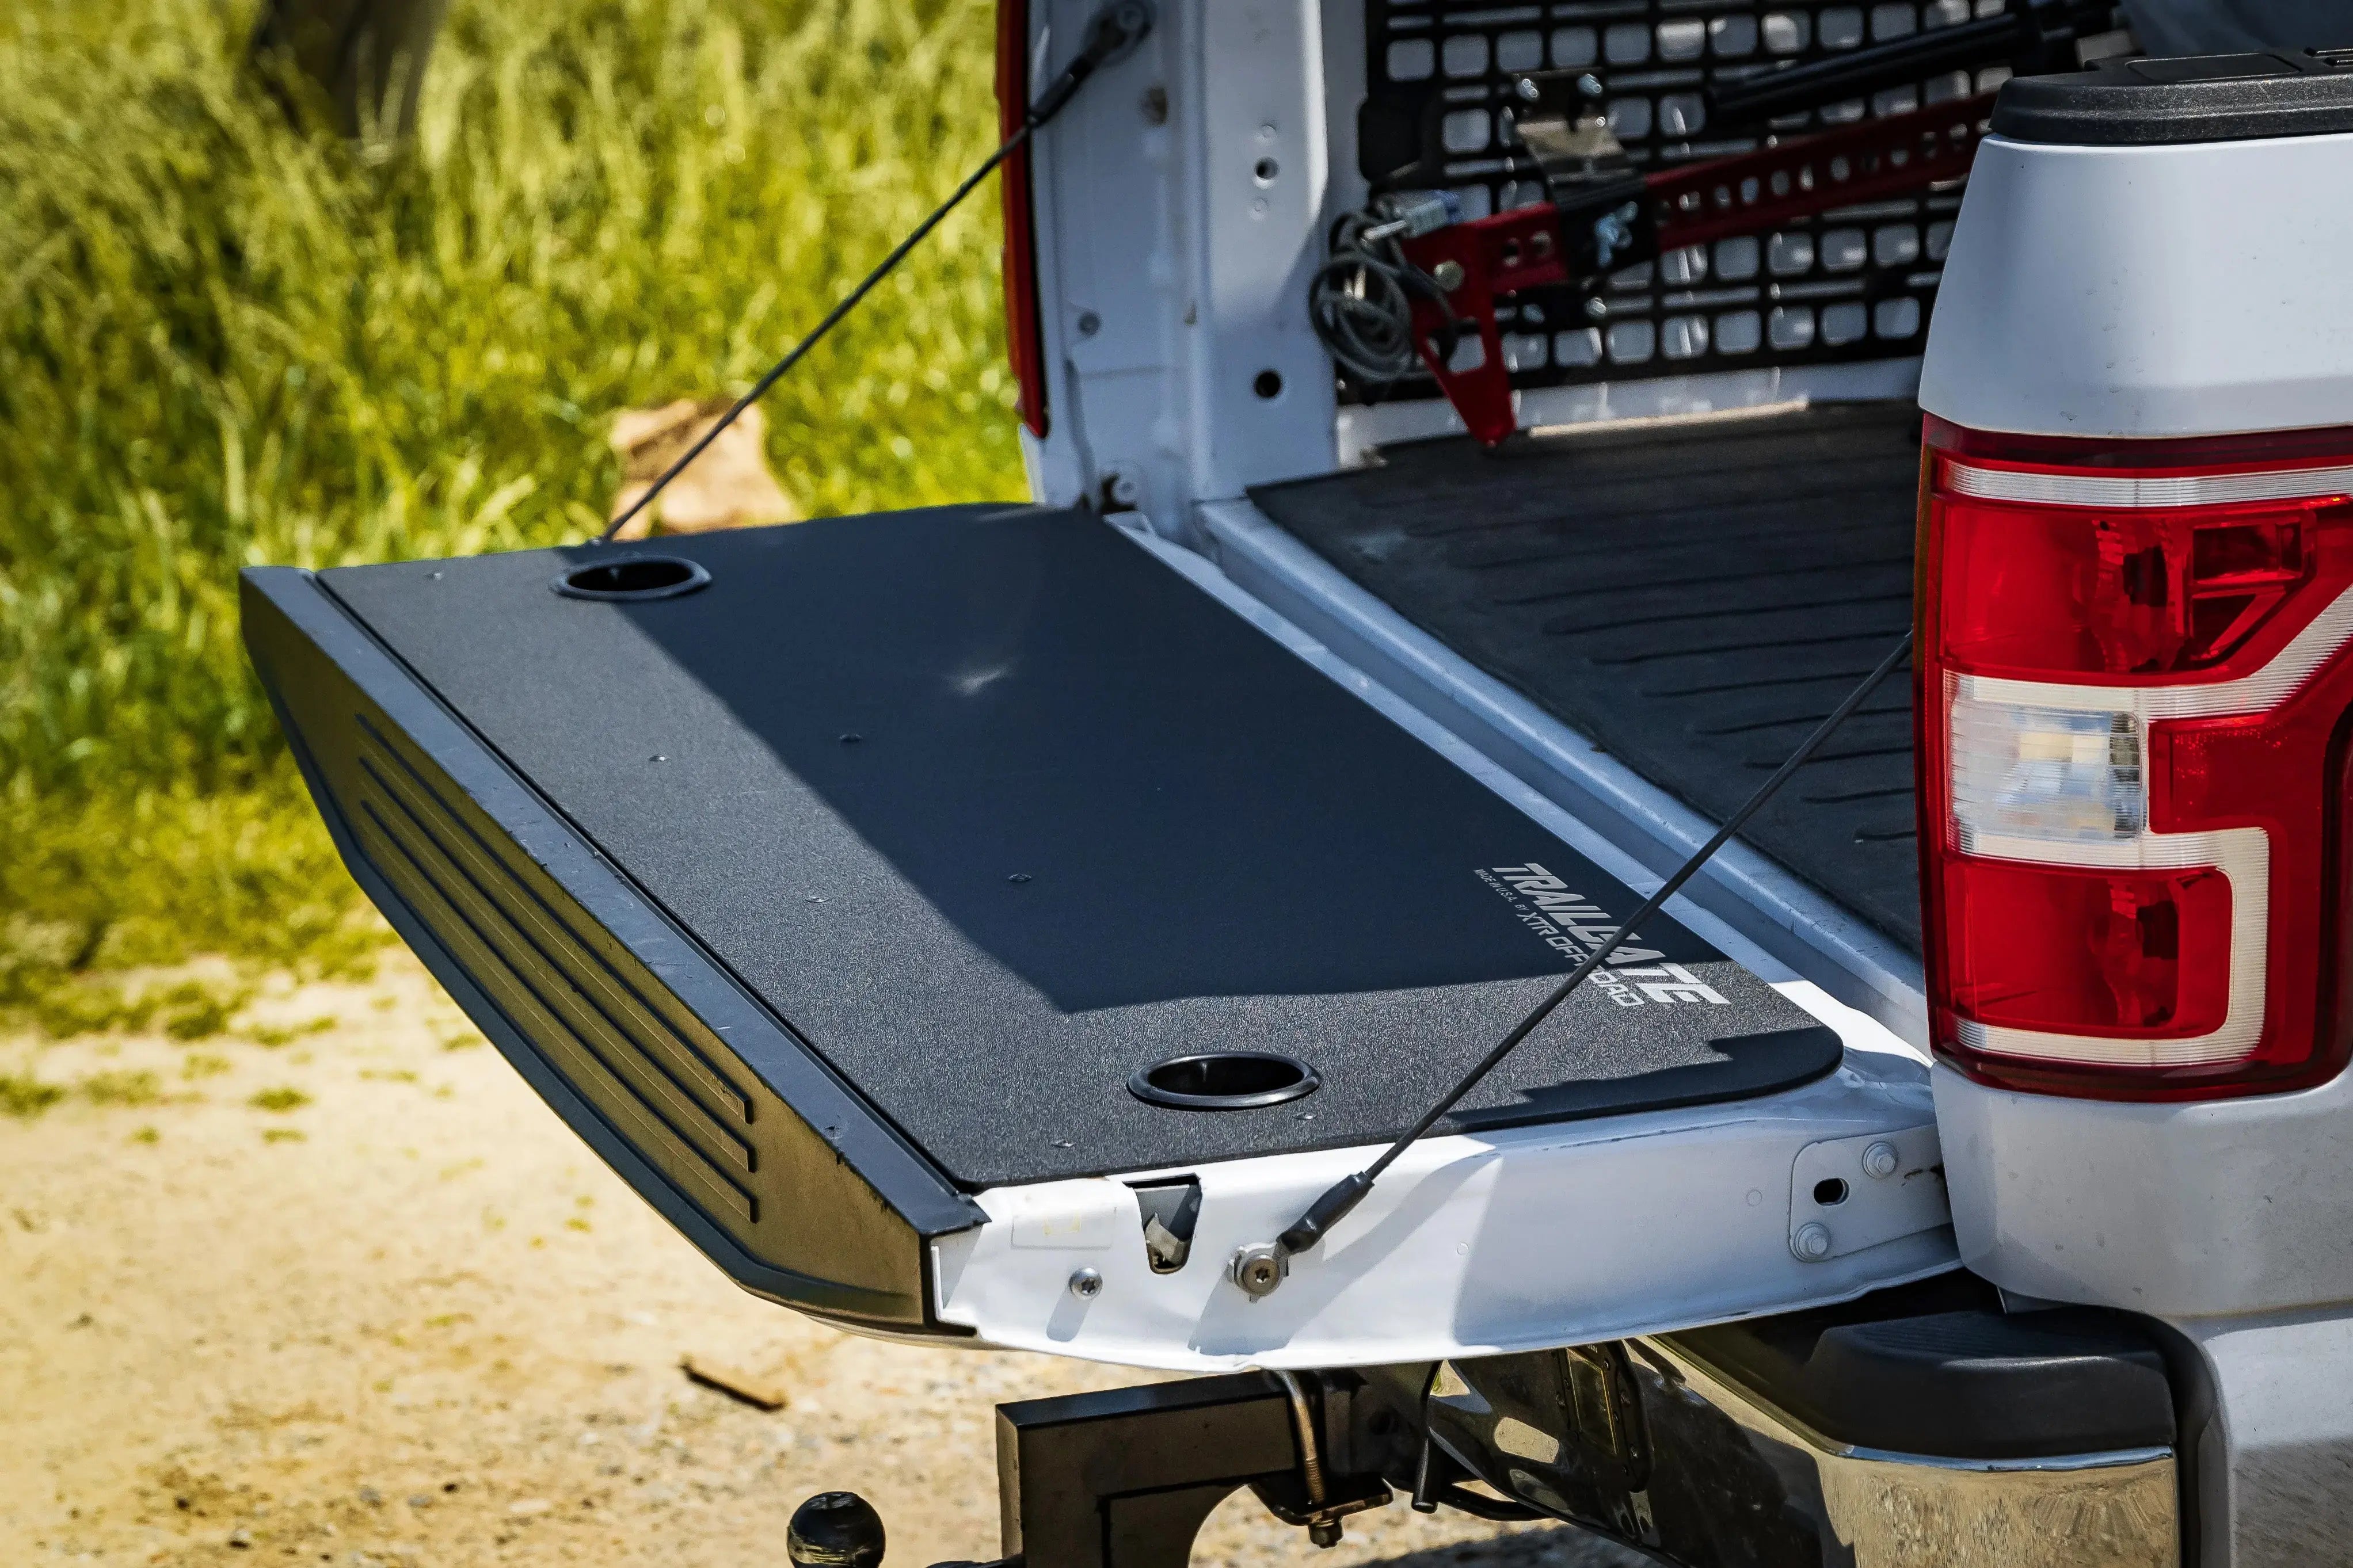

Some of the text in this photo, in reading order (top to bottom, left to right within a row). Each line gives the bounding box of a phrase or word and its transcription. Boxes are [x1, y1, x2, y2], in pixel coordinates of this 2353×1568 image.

[1474, 869, 1497, 883] MADE
[1495, 888, 1518, 902] U.S.A.
[1516, 912, 1560, 936] XTR
[1491, 863, 1731, 1004] TRAILGATE
